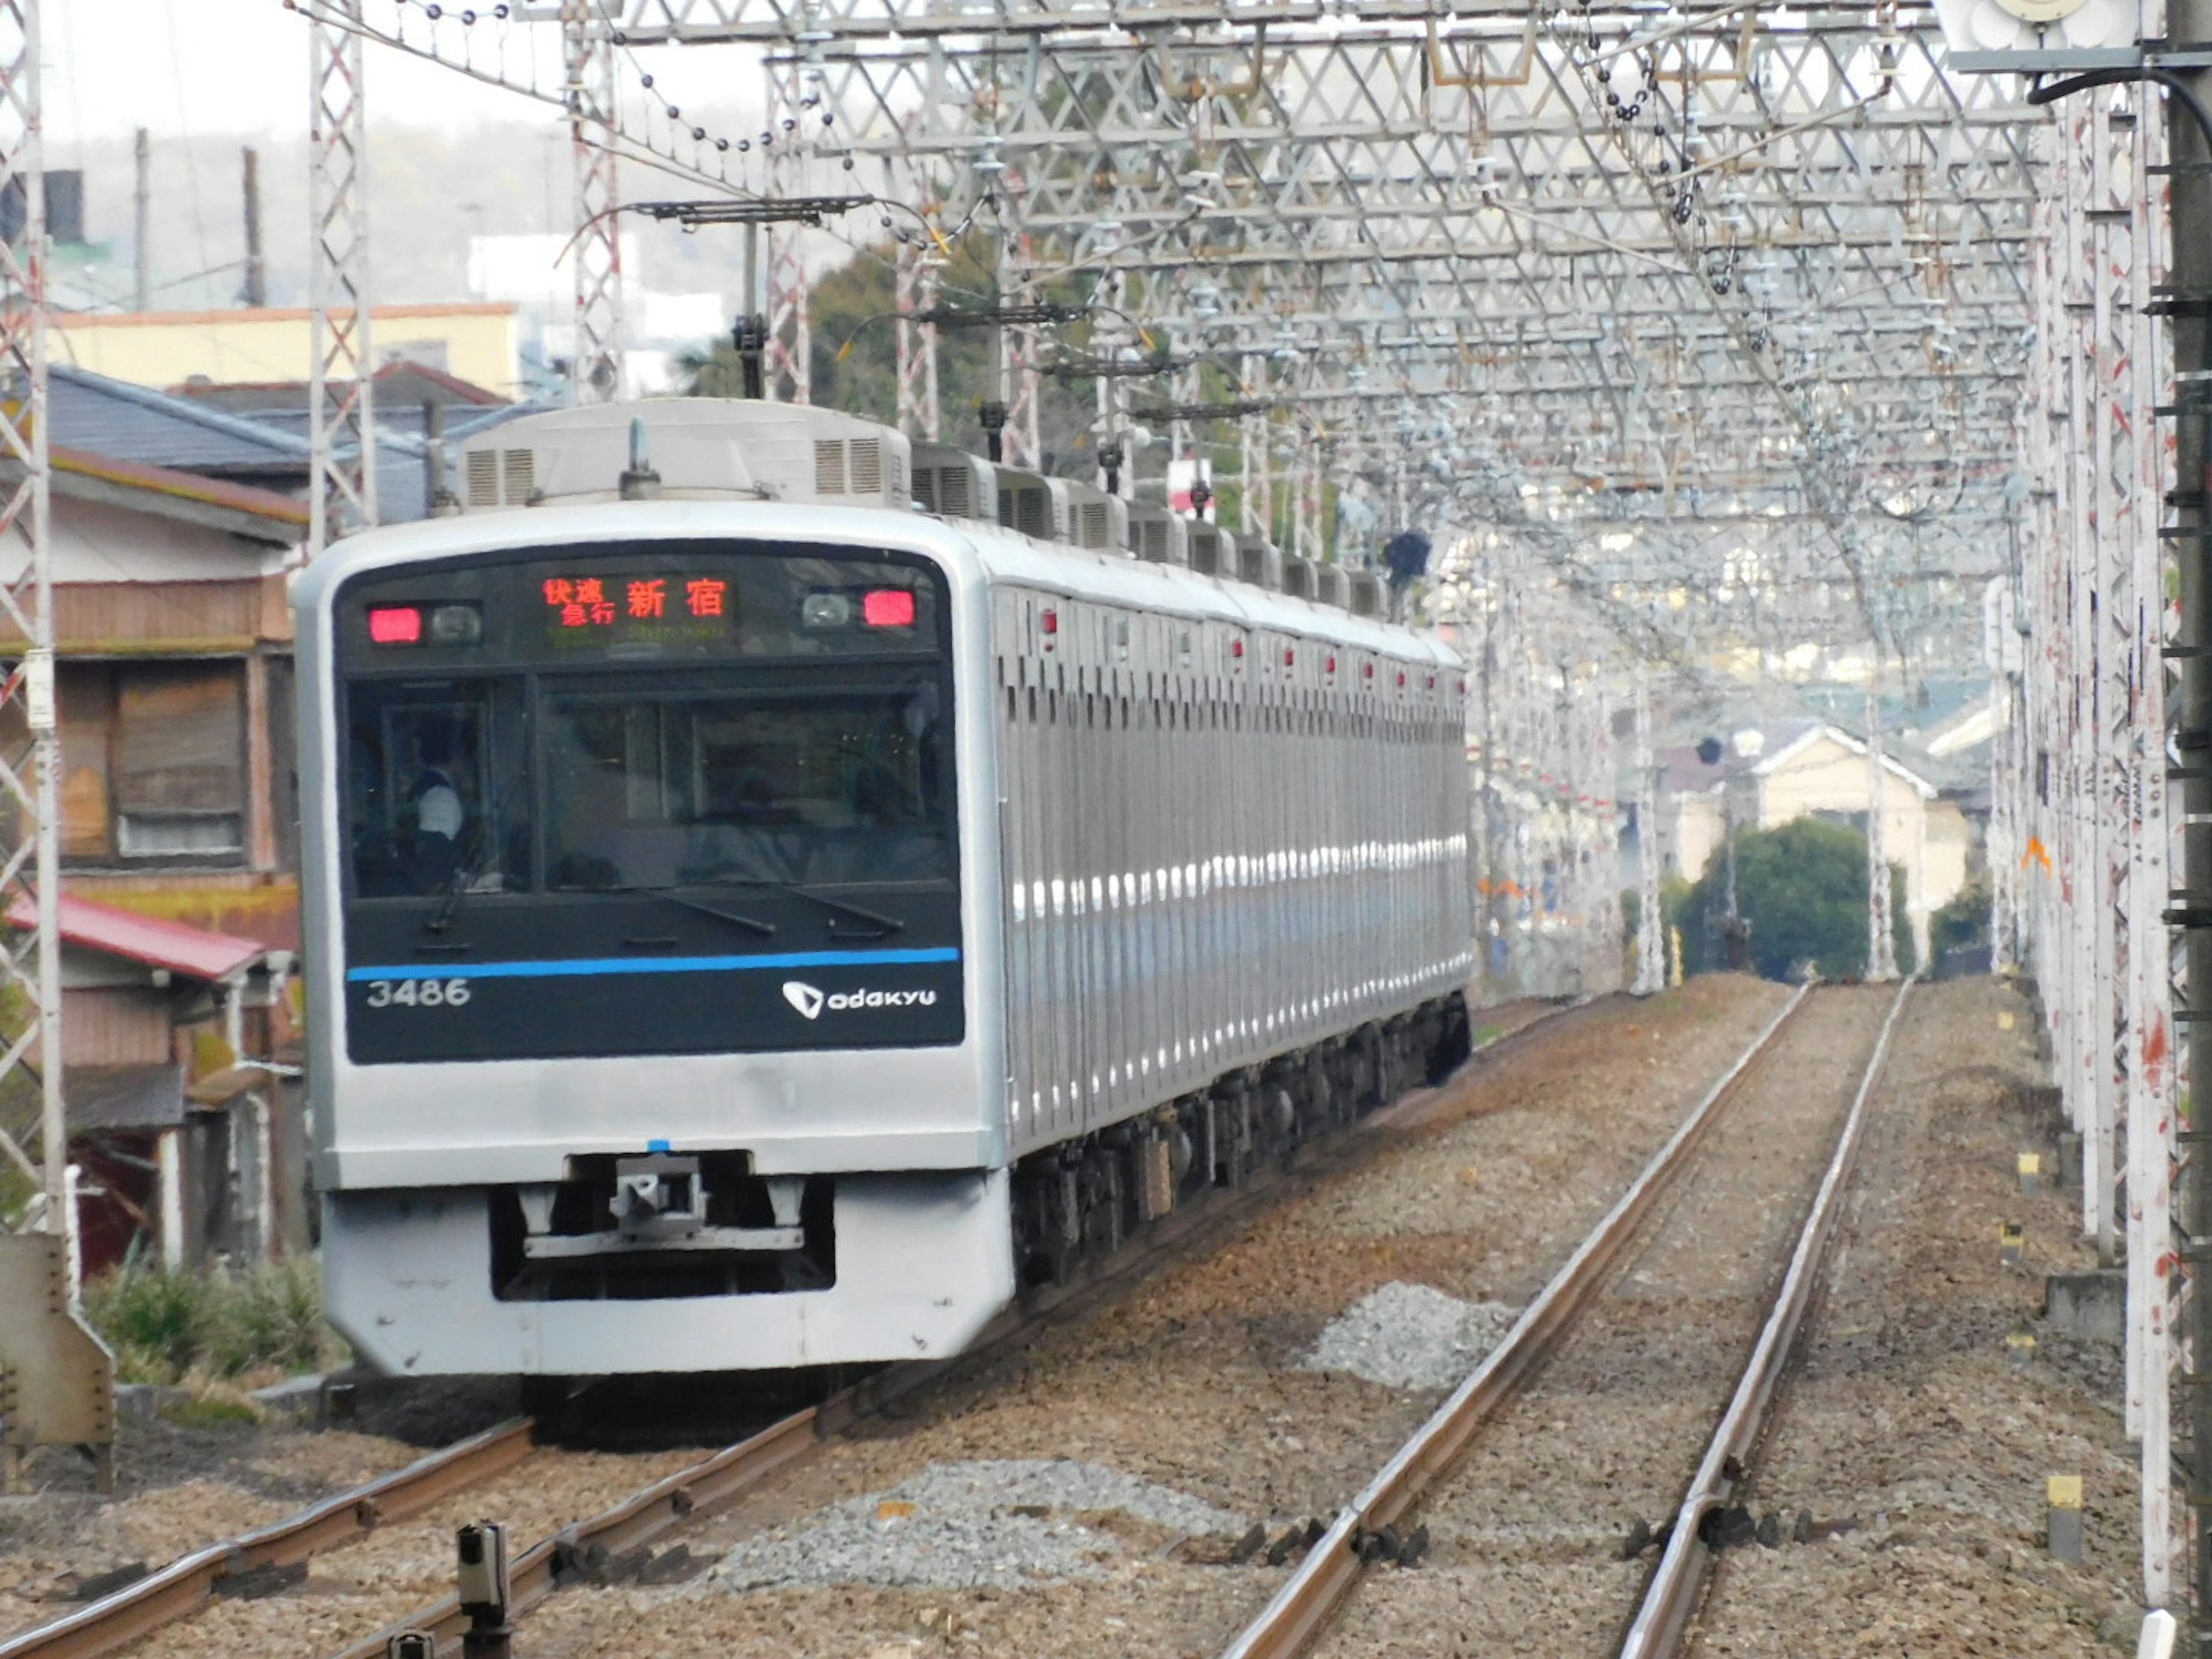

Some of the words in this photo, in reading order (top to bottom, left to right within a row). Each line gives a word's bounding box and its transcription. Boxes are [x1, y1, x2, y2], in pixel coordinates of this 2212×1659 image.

[543, 578, 603, 603] 快速
[628, 578, 725, 616] 新宿
[561, 603, 616, 626] 急行
[368, 978, 471, 1007] 3486
[828, 988, 936, 1010] odakyu
